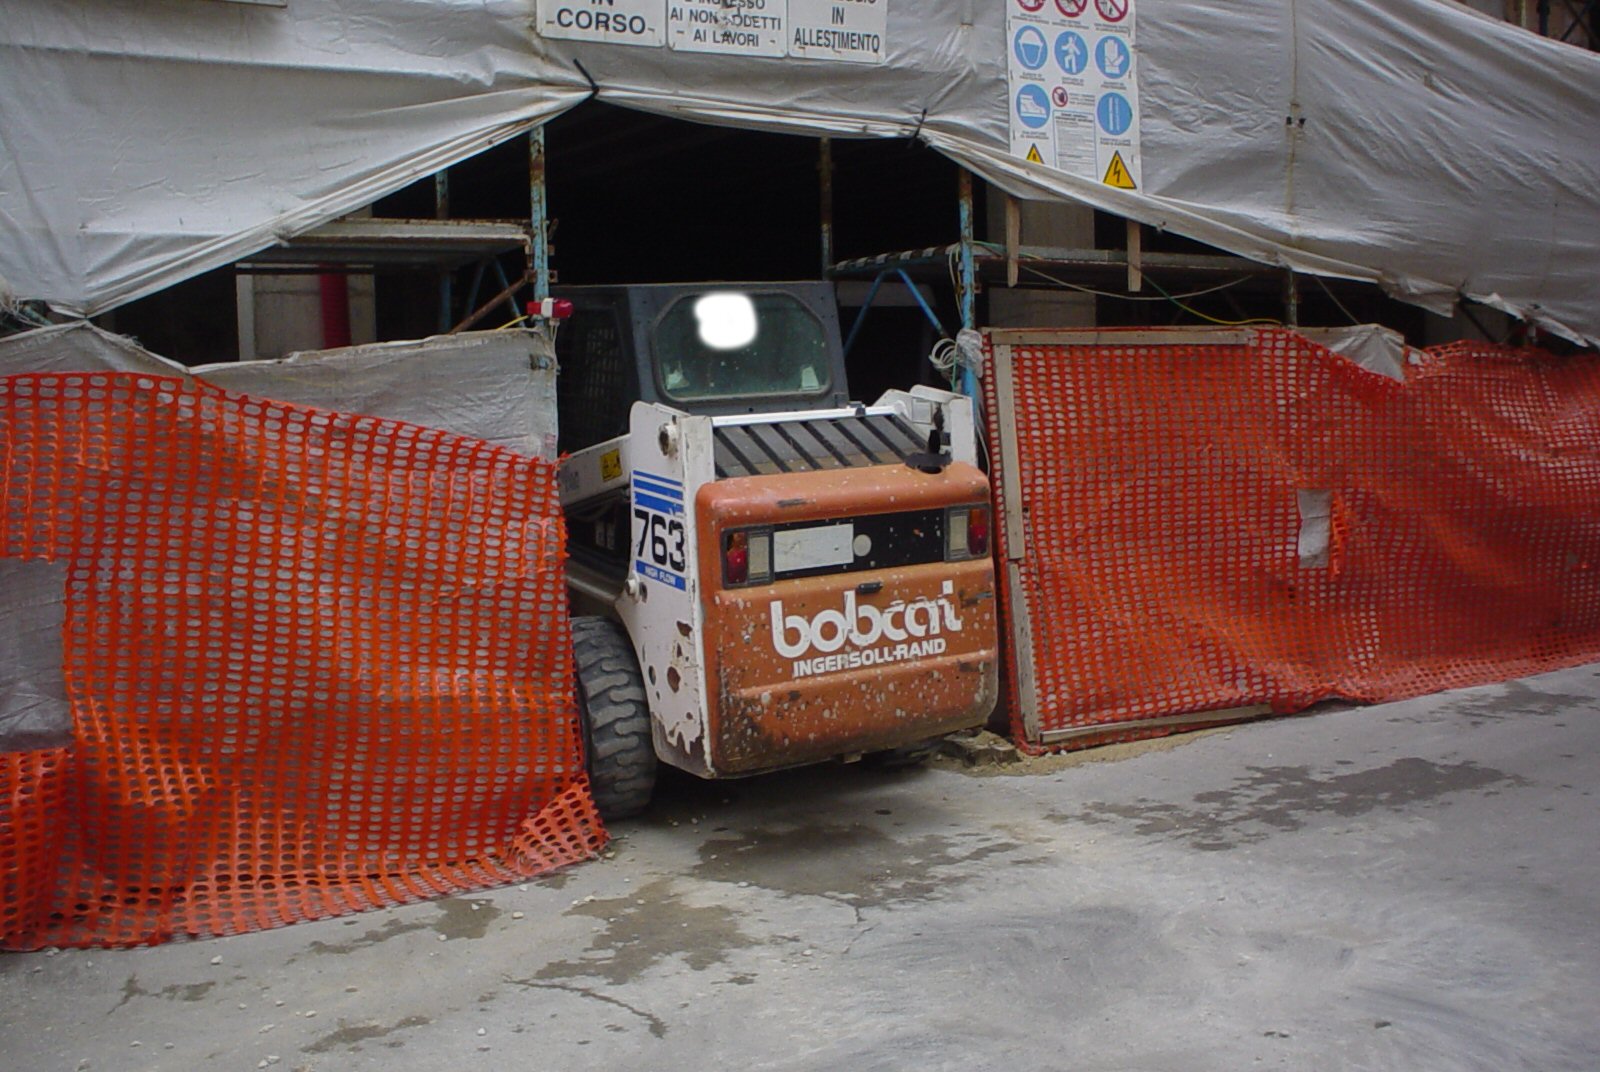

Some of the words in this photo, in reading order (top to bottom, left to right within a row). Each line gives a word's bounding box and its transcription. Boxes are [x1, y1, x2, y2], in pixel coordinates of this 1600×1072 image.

[556, 8, 646, 35] CORSO
[670, 7, 683, 21] AI
[689, 9, 719, 24] NON
[721, 13, 782, 31] DDETTI
[831, 6, 845, 25] IN
[693, 28, 707, 42] AI
[712, 30, 760, 47] LAVORI
[794, 27, 880, 53] ALLESTIMENTO
[633, 507, 686, 573] 763
[792, 638, 947, 678] INGERSOLL-RAND
